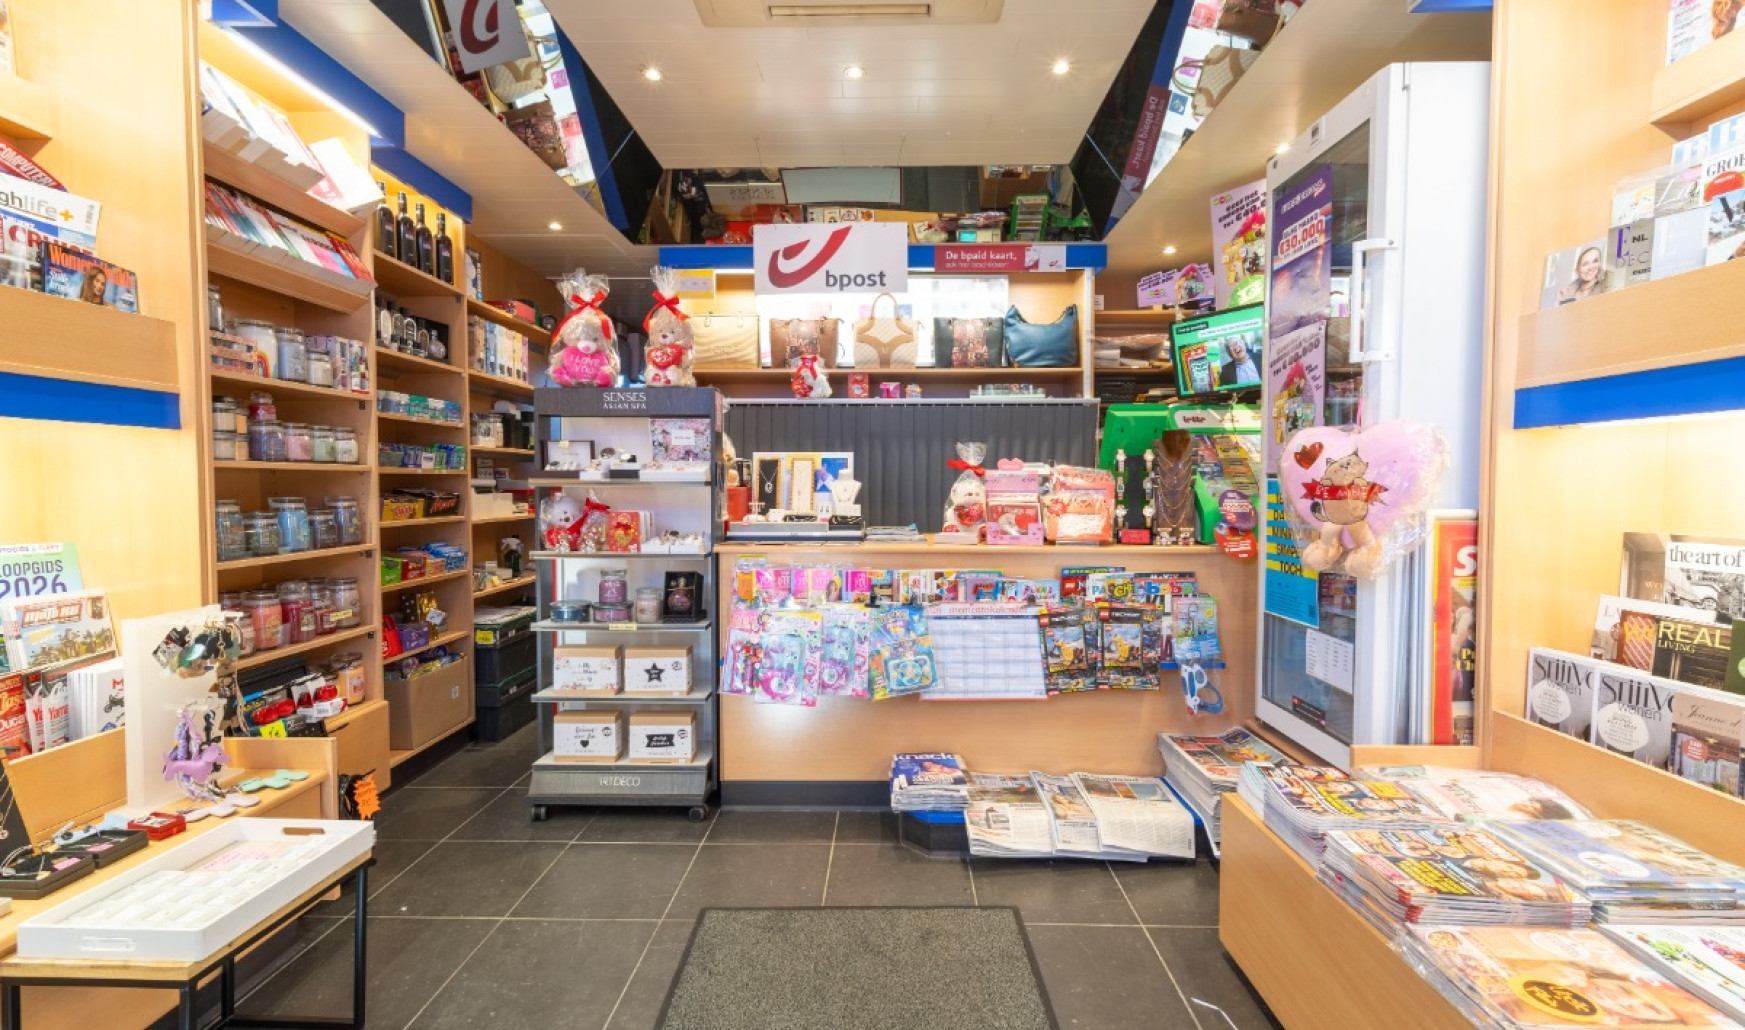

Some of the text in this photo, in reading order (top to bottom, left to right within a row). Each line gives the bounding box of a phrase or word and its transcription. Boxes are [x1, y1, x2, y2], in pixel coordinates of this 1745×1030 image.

[946, 250, 958, 260] De
[961, 250, 986, 262] bpaid
[825, 270, 886, 291] bpost
[603, 392, 647, 402] SENSES
[603, 402, 647, 410] ASIAN SPA
[1670, 545, 1743, 568] the art of
[0, 560, 63, 578] OOPGIDS
[1145, 581, 1194, 595] bobo
[1658, 620, 1731, 650] REAL
[1658, 640, 1695, 653] LIVING
